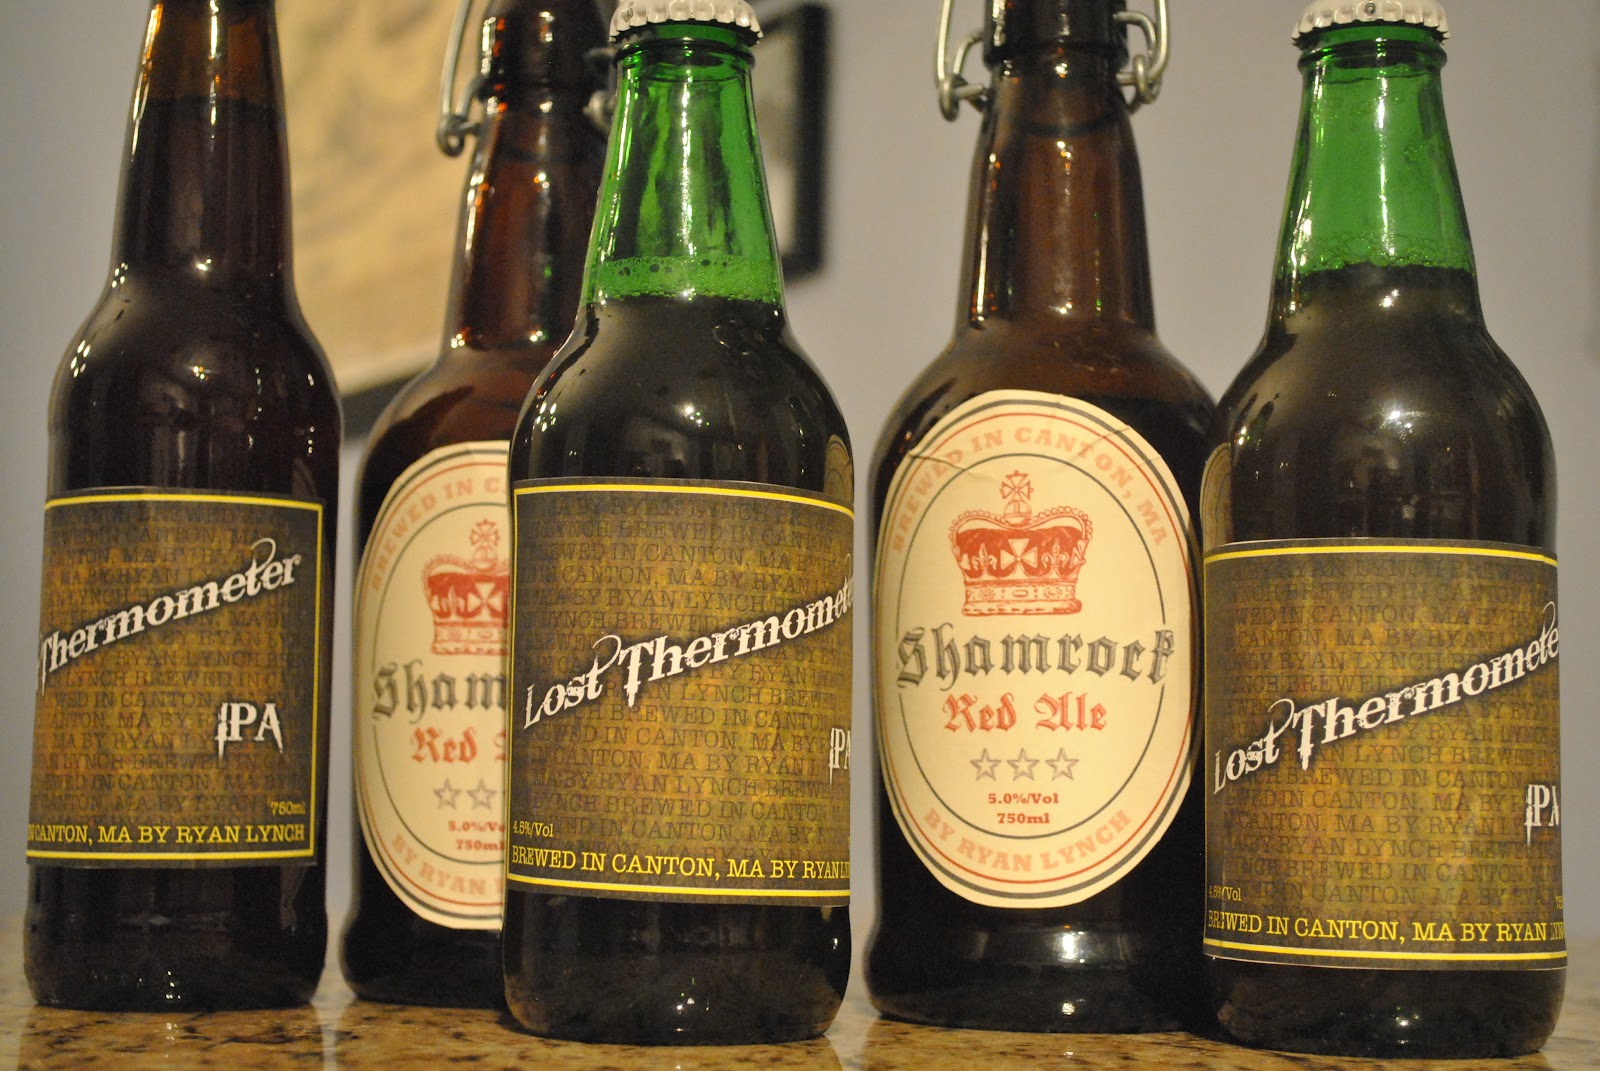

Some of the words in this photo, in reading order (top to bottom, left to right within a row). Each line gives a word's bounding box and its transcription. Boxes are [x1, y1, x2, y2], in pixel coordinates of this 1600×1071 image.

[442, 478, 474, 500] IN
[892, 448, 964, 553] BREWED
[971, 429, 1003, 452] IN
[1014, 427, 1136, 501] CANTON,
[1136, 498, 1170, 546] MA
[669, 568, 705, 588] MA
[715, 570, 746, 590] BY
[608, 590, 679, 609] RYAN
[1334, 628, 1378, 647] MA
[895, 621, 1175, 693] Shamrock
[523, 635, 622, 730] Lost
[1213, 698, 1294, 795] Lost
[1290, 600, 1559, 772] Thermomete
[610, 702, 716, 727] BREWED
[723, 707, 749, 727] IN
[942, 691, 1018, 734] Red
[1034, 691, 1107, 733] Ale
[215, 702, 284, 760] IPA
[410, 726, 478, 764] Red
[657, 751, 698, 771] MA
[706, 753, 738, 774] BY
[987, 792, 1060, 805] 5.0%/Vol
[512, 820, 554, 837] 4.5%/Vol
[996, 812, 1051, 825] 750ml
[1335, 814, 1377, 833] MA
[1386, 815, 1422, 836] BY
[98, 826, 133, 843] MA
[140, 825, 169, 843] BY
[177, 825, 240, 843] RYAN
[245, 824, 305, 842] LYNCH
[923, 807, 956, 841] BY
[956, 838, 1033, 873] RYAN
[1042, 809, 1132, 872] LYNCH
[511, 846, 577, 869] BREWED
[580, 853, 606, 875] IN
[611, 856, 720, 881] CANTON,
[727, 858, 766, 878] MA
[770, 860, 799, 879] BY
[802, 861, 839, 879] RYAN
[420, 862, 487, 896] RYAN
[1208, 910, 1263, 933] BREWED
[1266, 915, 1290, 936] IN
[1294, 918, 1406, 945] CANTON,
[1411, 922, 1456, 942] MA
[1460, 923, 1489, 943] BY
[1499, 923, 1547, 942] RYAN
